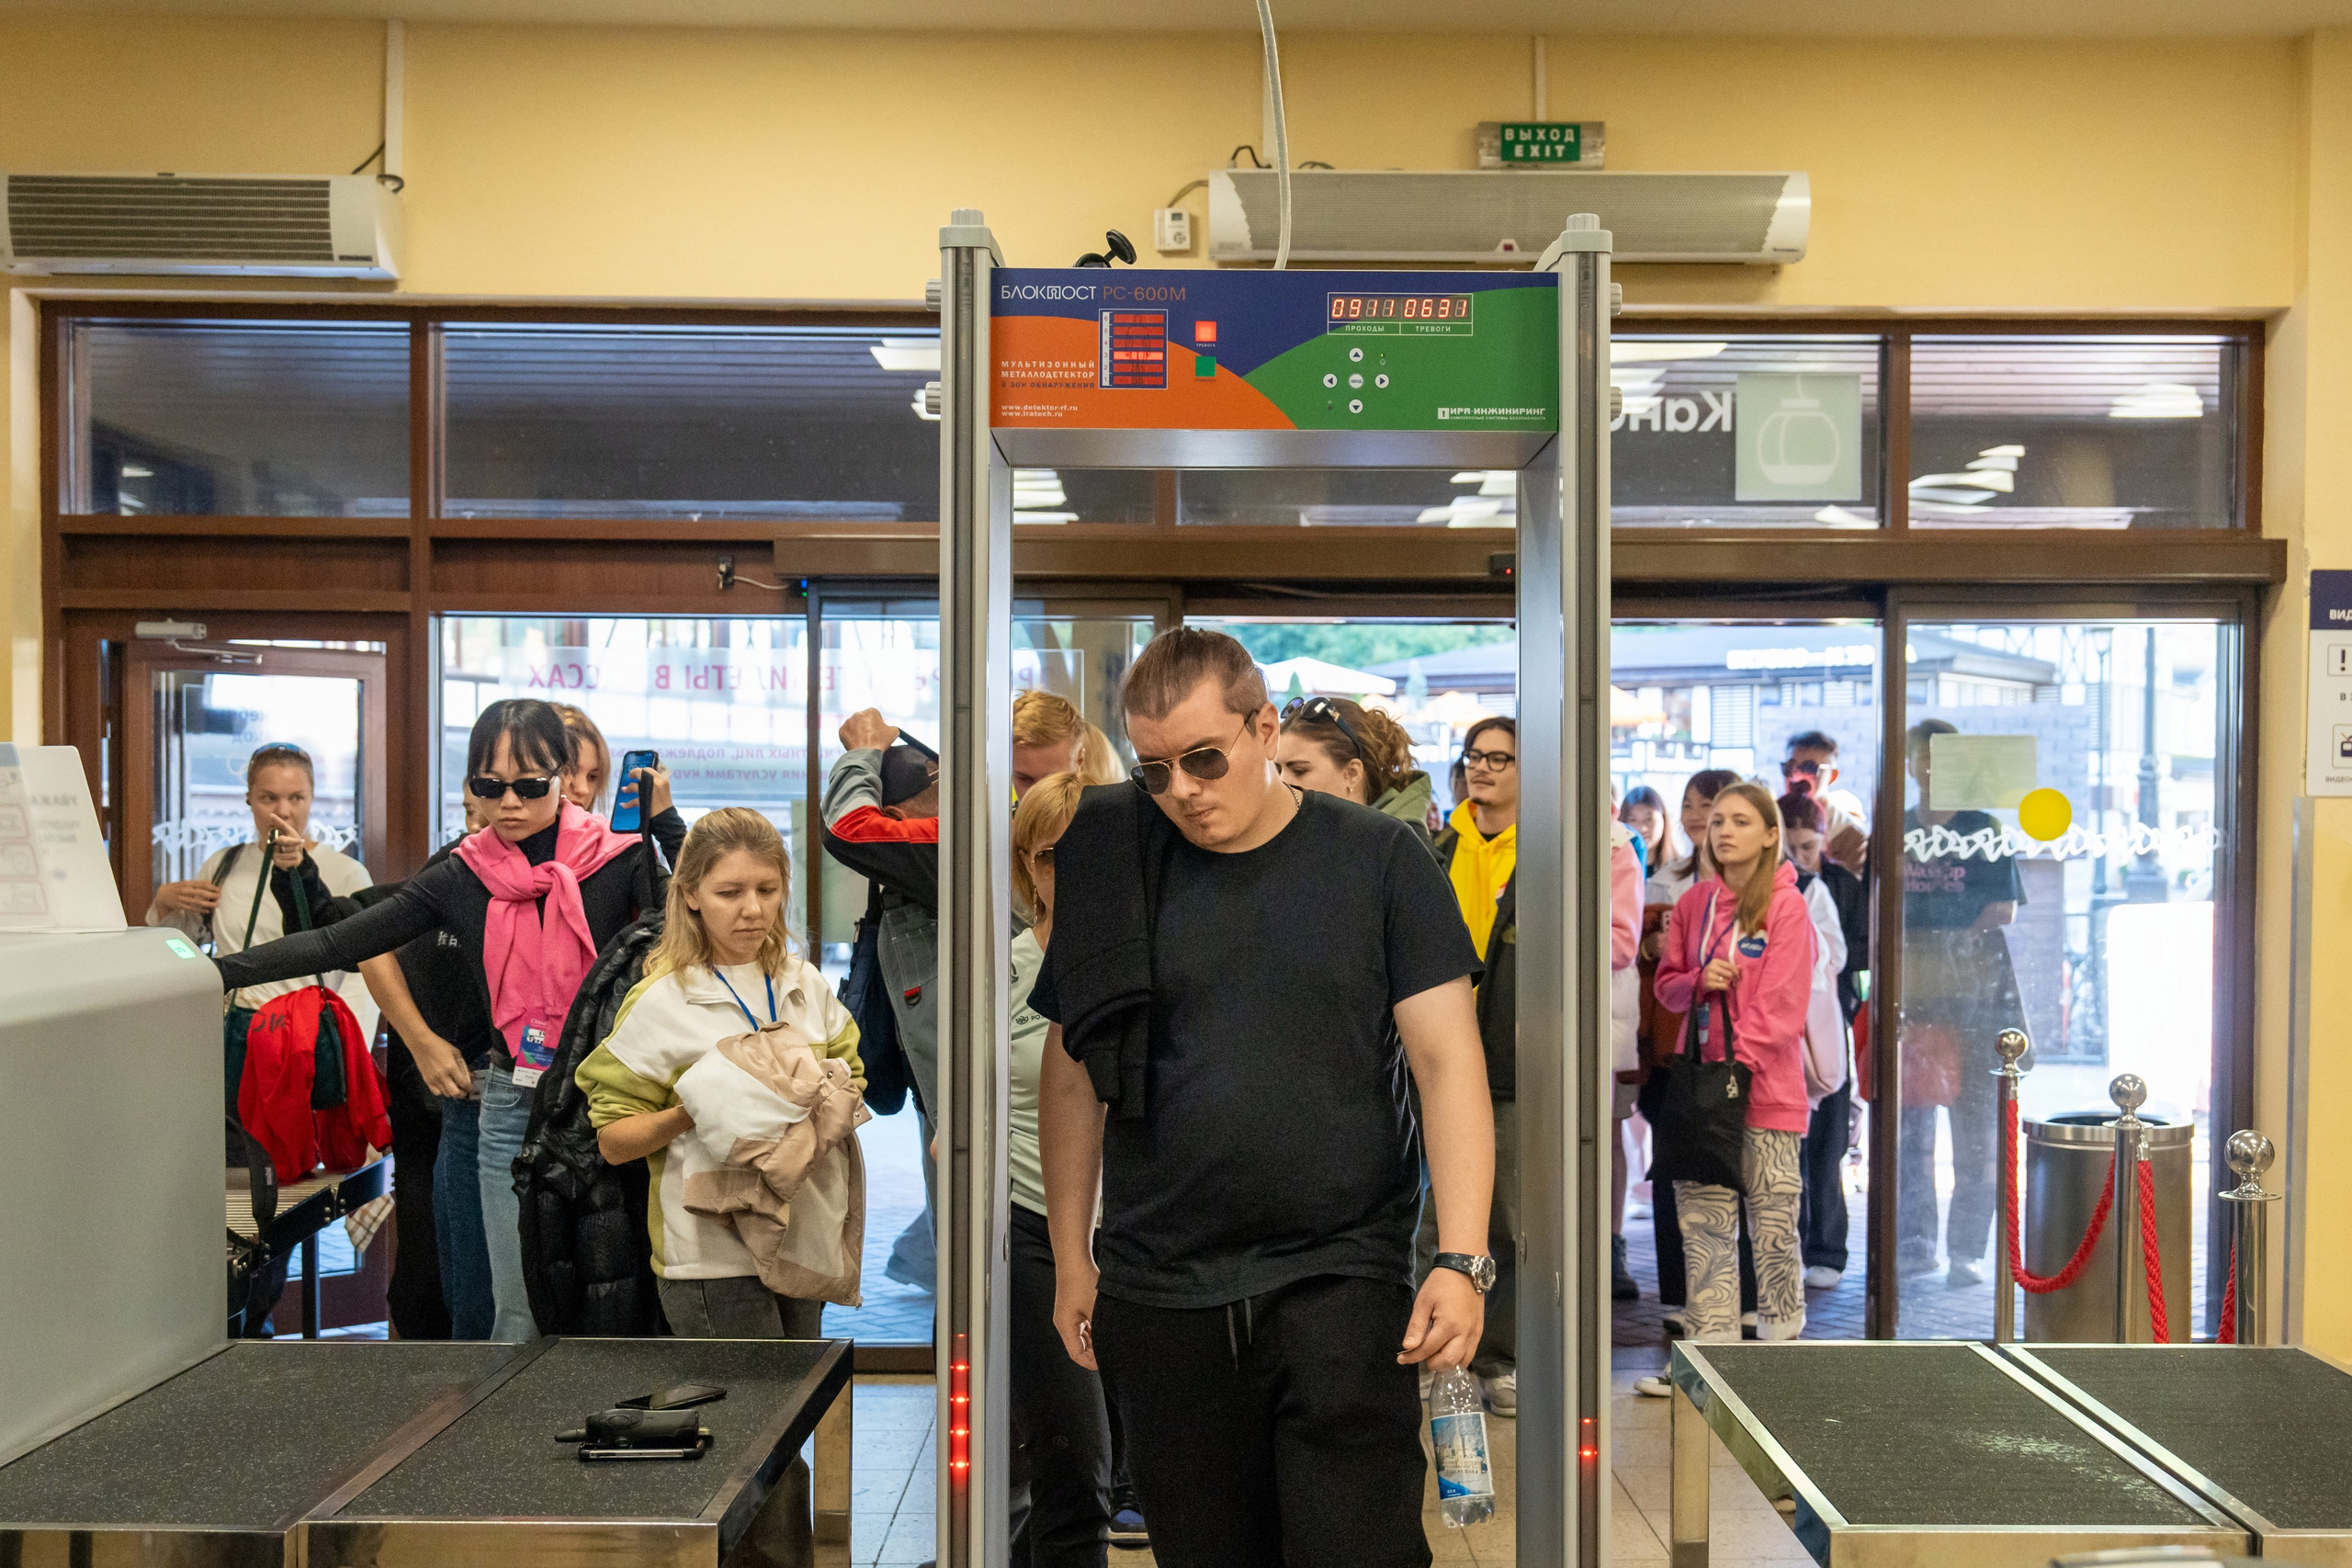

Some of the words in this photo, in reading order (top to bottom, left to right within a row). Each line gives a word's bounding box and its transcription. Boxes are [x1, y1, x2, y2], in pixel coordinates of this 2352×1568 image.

[1504, 128, 1576, 143] ВЫХОД
[1514, 144, 1566, 158] EXIT
[1001, 285, 1097, 300] БЛОКПОСТ
[1331, 299, 1396, 319] 0911
[1404, 299, 1467, 319] 0631
[1001, 360, 1095, 368] МУЛЬТИЗОННЫЙ
[1001, 370, 1095, 379] МЕТАЛЛОДЕТЕКТОР
